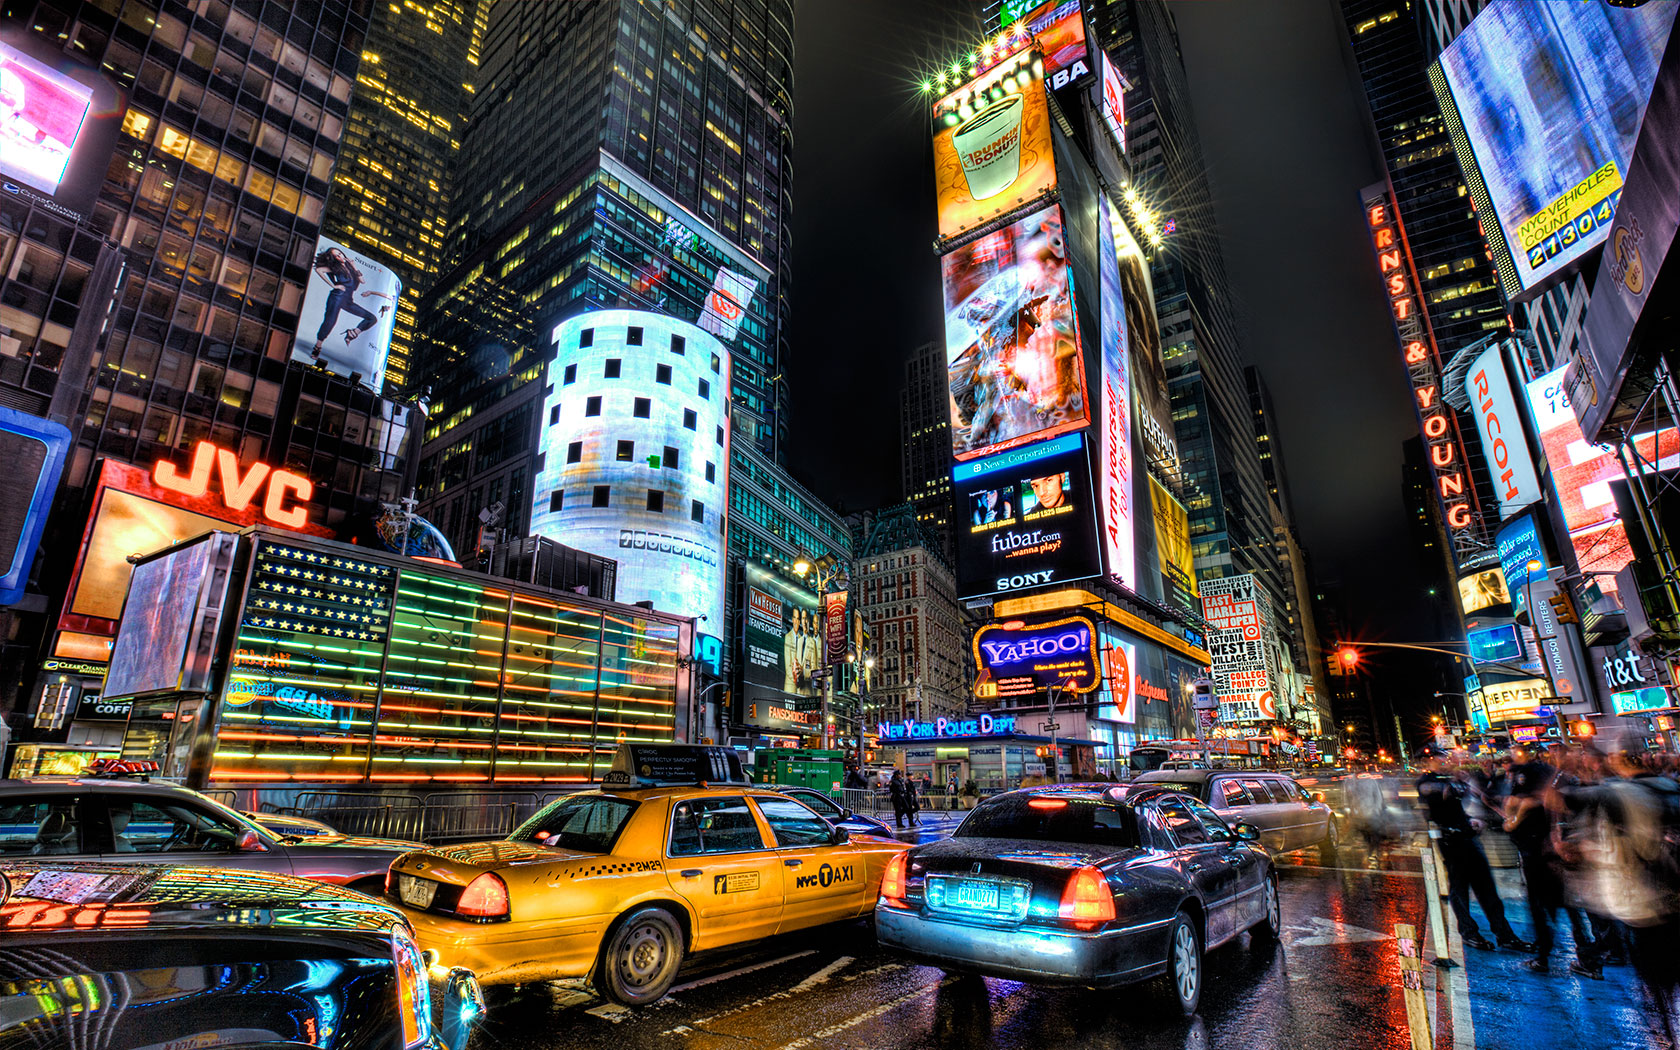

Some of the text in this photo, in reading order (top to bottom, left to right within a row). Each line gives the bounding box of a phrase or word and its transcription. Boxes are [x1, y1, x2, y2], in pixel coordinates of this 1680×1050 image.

[975, 132, 1018, 166] DONUTS
[1520, 163, 1615, 236] NYC VEHICLES
[1525, 210, 1570, 247] COUNT
[354, 255, 378, 271] Smart
[1370, 206, 1471, 528] ERNST & YOUNG
[1118, 394, 1126, 443] ones
[1140, 403, 1176, 460] BUFFALO
[1474, 369, 1519, 501] RICOH
[984, 443, 1061, 471] News Corporation
[1107, 380, 1119, 549] Arm yourself
[1118, 446, 1127, 482] the
[153, 441, 312, 529] JVC
[1119, 484, 1127, 520] for
[1039, 540, 1062, 554] play?
[997, 570, 1054, 590] SONY
[1204, 595, 1229, 607] EAST
[1232, 586, 1252, 599] NY
[829, 615, 843, 625] FREE
[1206, 602, 1254, 620] HARLEM
[1230, 614, 1256, 627] OPEN
[1538, 600, 1553, 635] REUTERS
[830, 624, 842, 632] WIFI
[982, 630, 1089, 664] YAHOO!
[1209, 634, 1244, 645] ASTORIA
[1209, 642, 1245, 656] WEST
[1211, 654, 1247, 665] VILLAGE
[1246, 641, 1257, 661] SOHO
[1230, 670, 1267, 680] COLLEGE
[1603, 650, 1645, 689] at&t
[1135, 674, 1169, 704] Walgreens
[1215, 674, 1224, 689] BAY
[1231, 680, 1255, 688] POINT
[1219, 694, 1252, 703] MARBLE
[1228, 702, 1258, 711] MILL
[1485, 693, 1499, 706] THE
[878, 713, 1016, 739] NEW YORK POLICE DEPT
[635, 860, 662, 872] 2M29
[796, 863, 853, 888] NYC TAXI
[959, 888, 996, 903] GRAND277
